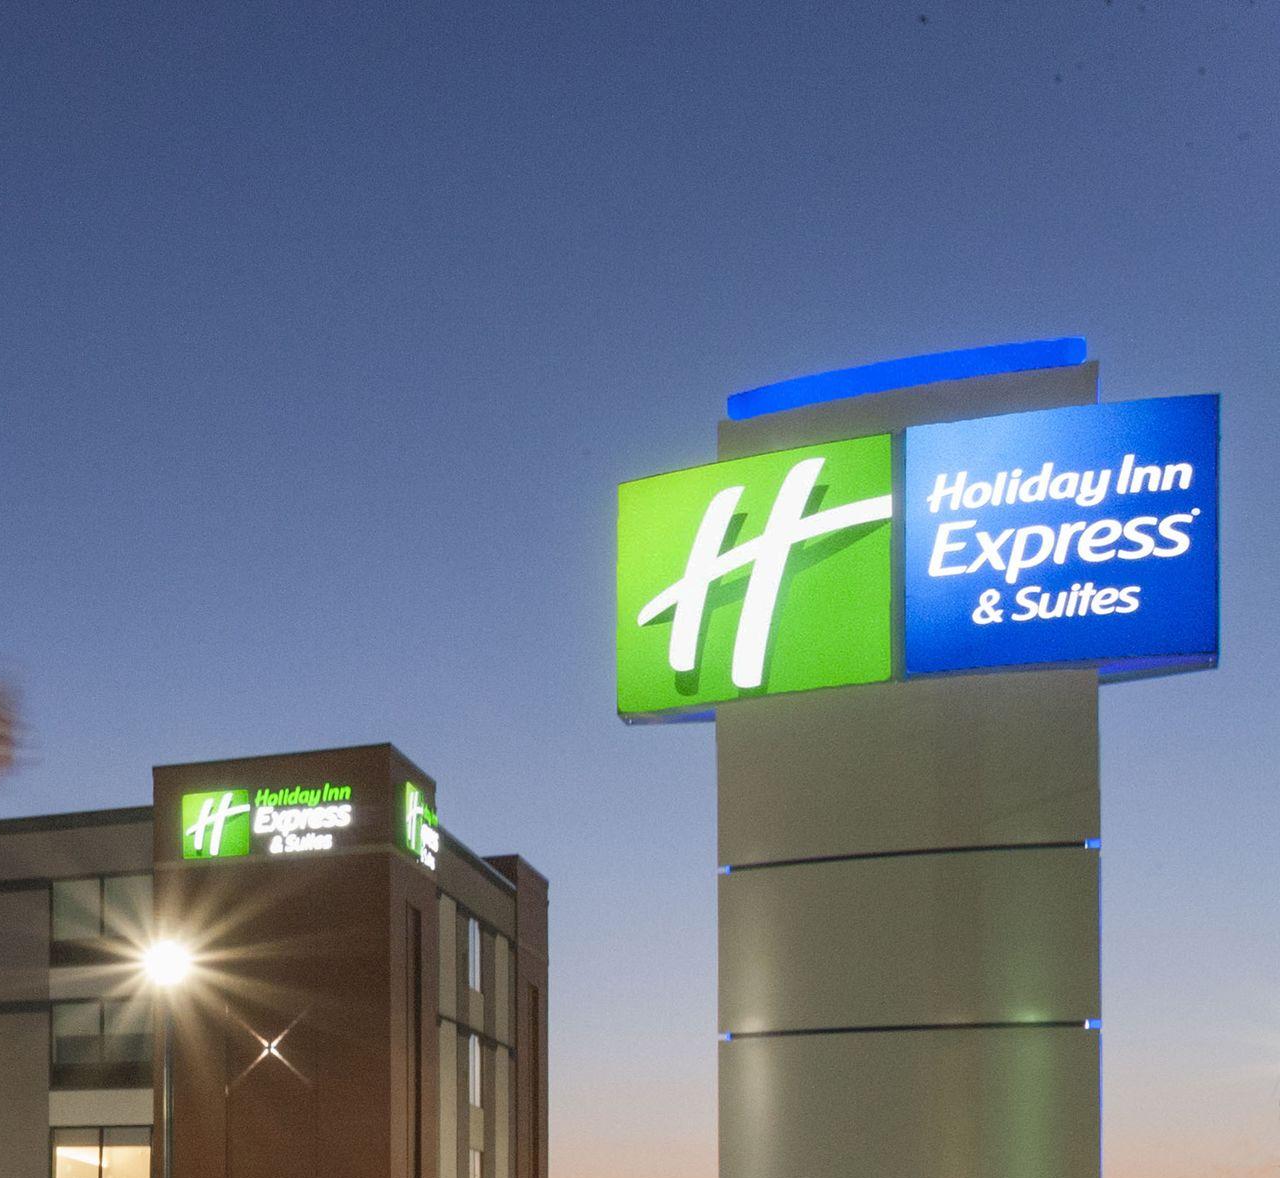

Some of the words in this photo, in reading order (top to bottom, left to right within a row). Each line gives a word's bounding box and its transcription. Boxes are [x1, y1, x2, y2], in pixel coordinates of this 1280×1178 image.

[926, 462, 1112, 513] Holiday
[1116, 454, 1193, 495] Inn
[927, 513, 1194, 585] Express
[972, 588, 1004, 625] &
[1011, 582, 1141, 621] Suites
[254, 785, 322, 808] Holiday
[322, 782, 352, 802] Inn
[253, 804, 352, 837] Express
[284, 832, 333, 852] Suites
